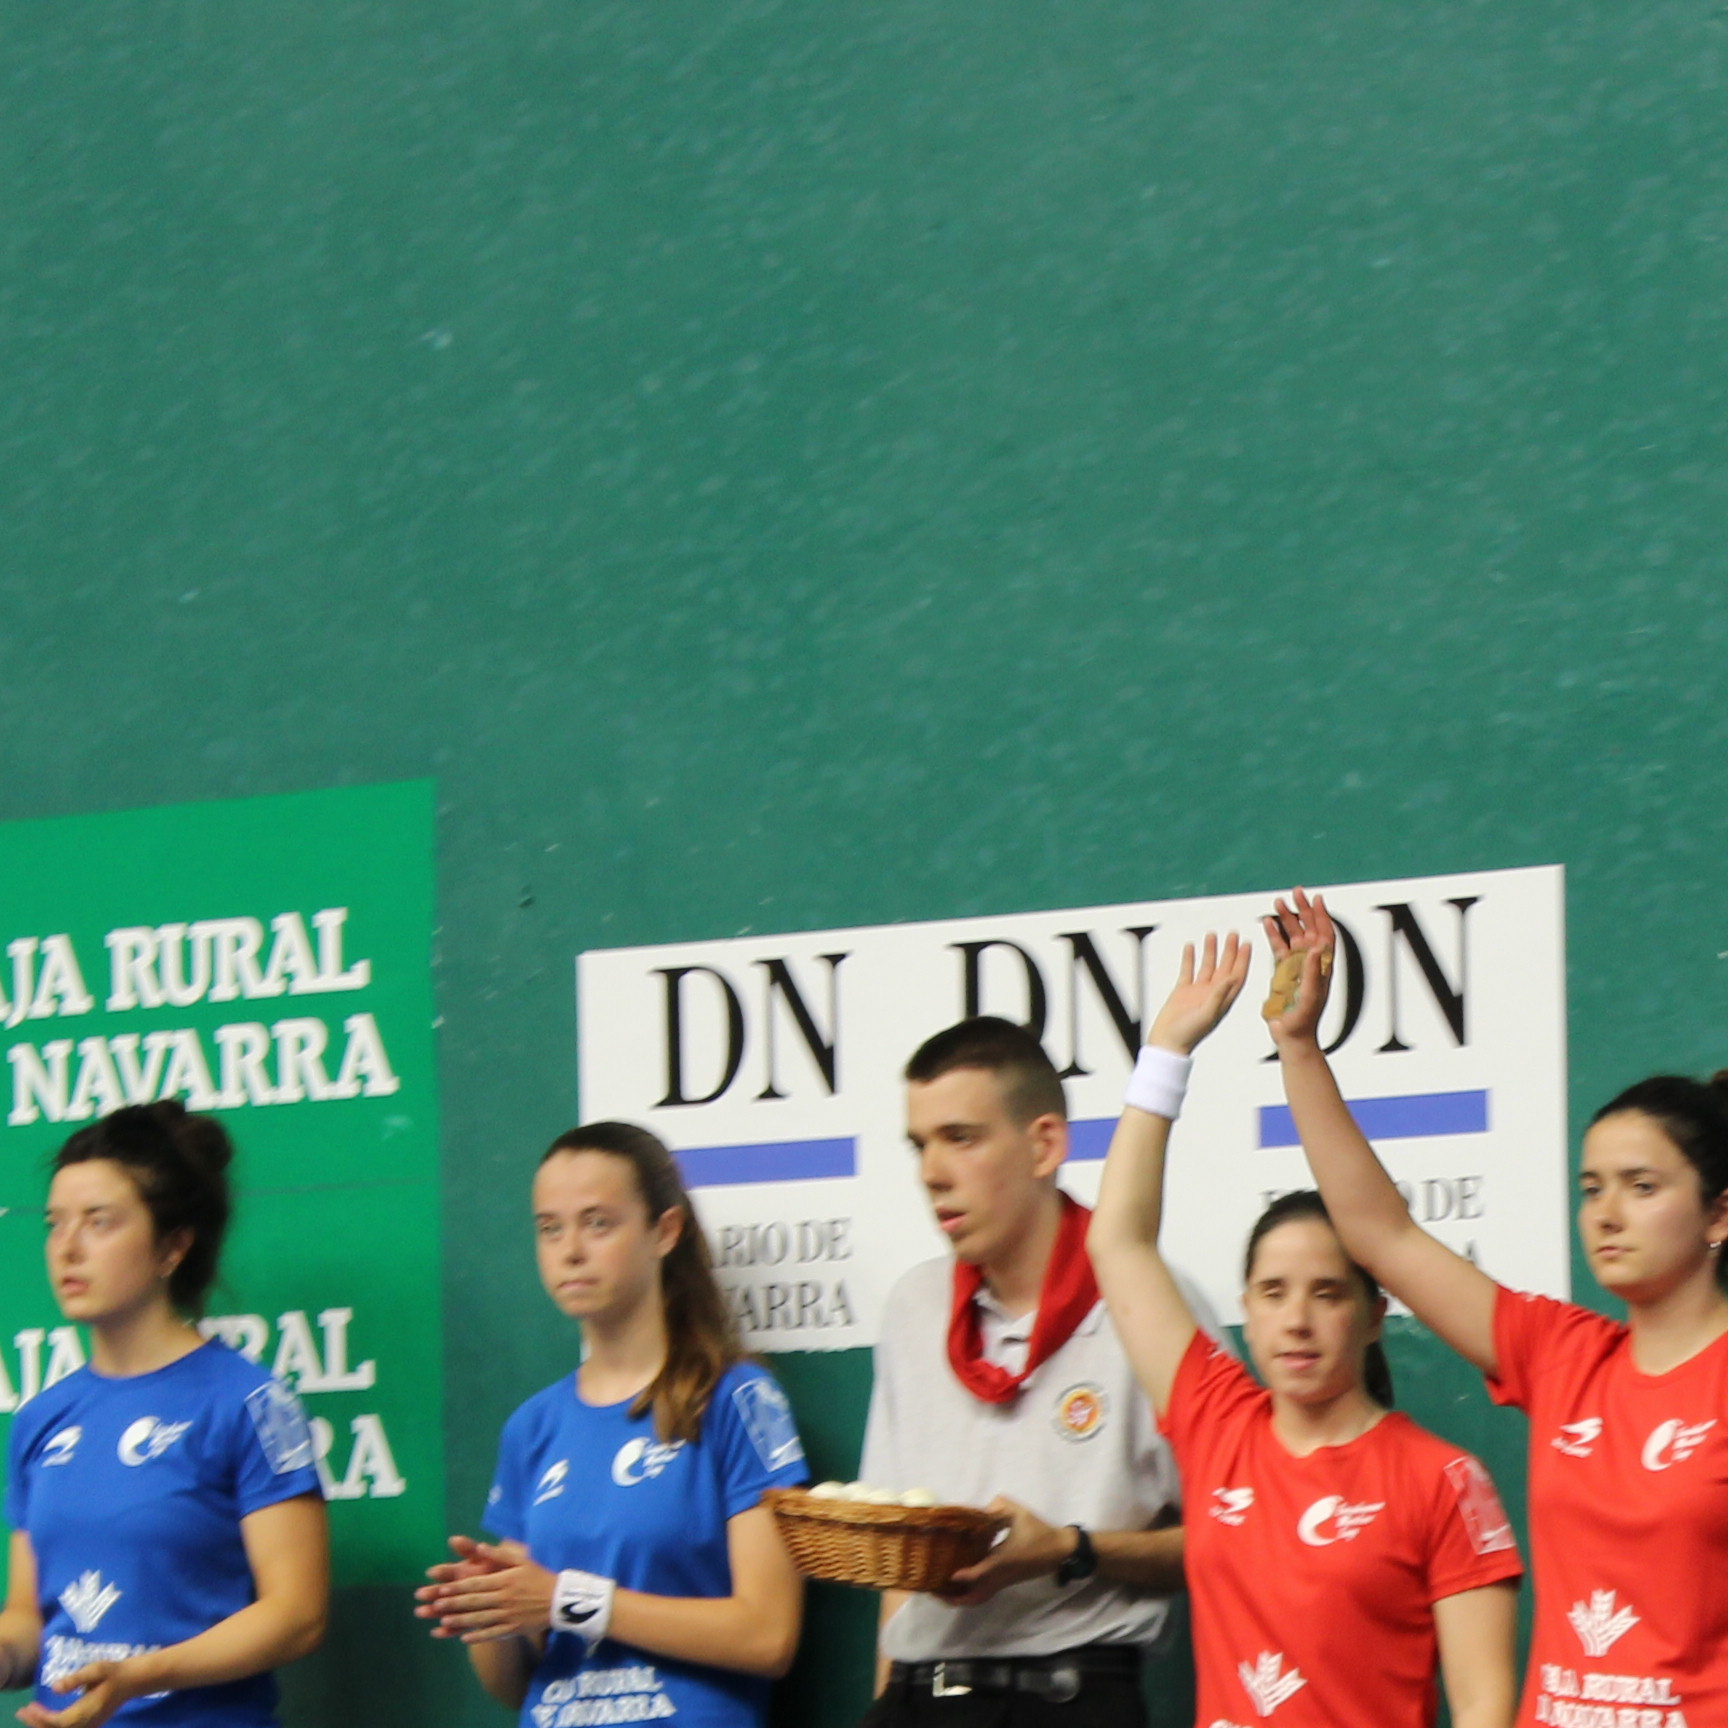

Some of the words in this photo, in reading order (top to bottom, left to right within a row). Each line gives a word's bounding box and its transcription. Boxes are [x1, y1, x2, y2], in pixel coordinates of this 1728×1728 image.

[104, 906, 373, 1013] RURAL
[947, 924, 1158, 1079] DN
[7, 1012, 400, 1127] NAVARRA
[650, 951, 850, 1108] DN
[795, 1216, 854, 1264] DE
[1422, 1175, 1484, 1222] DE
